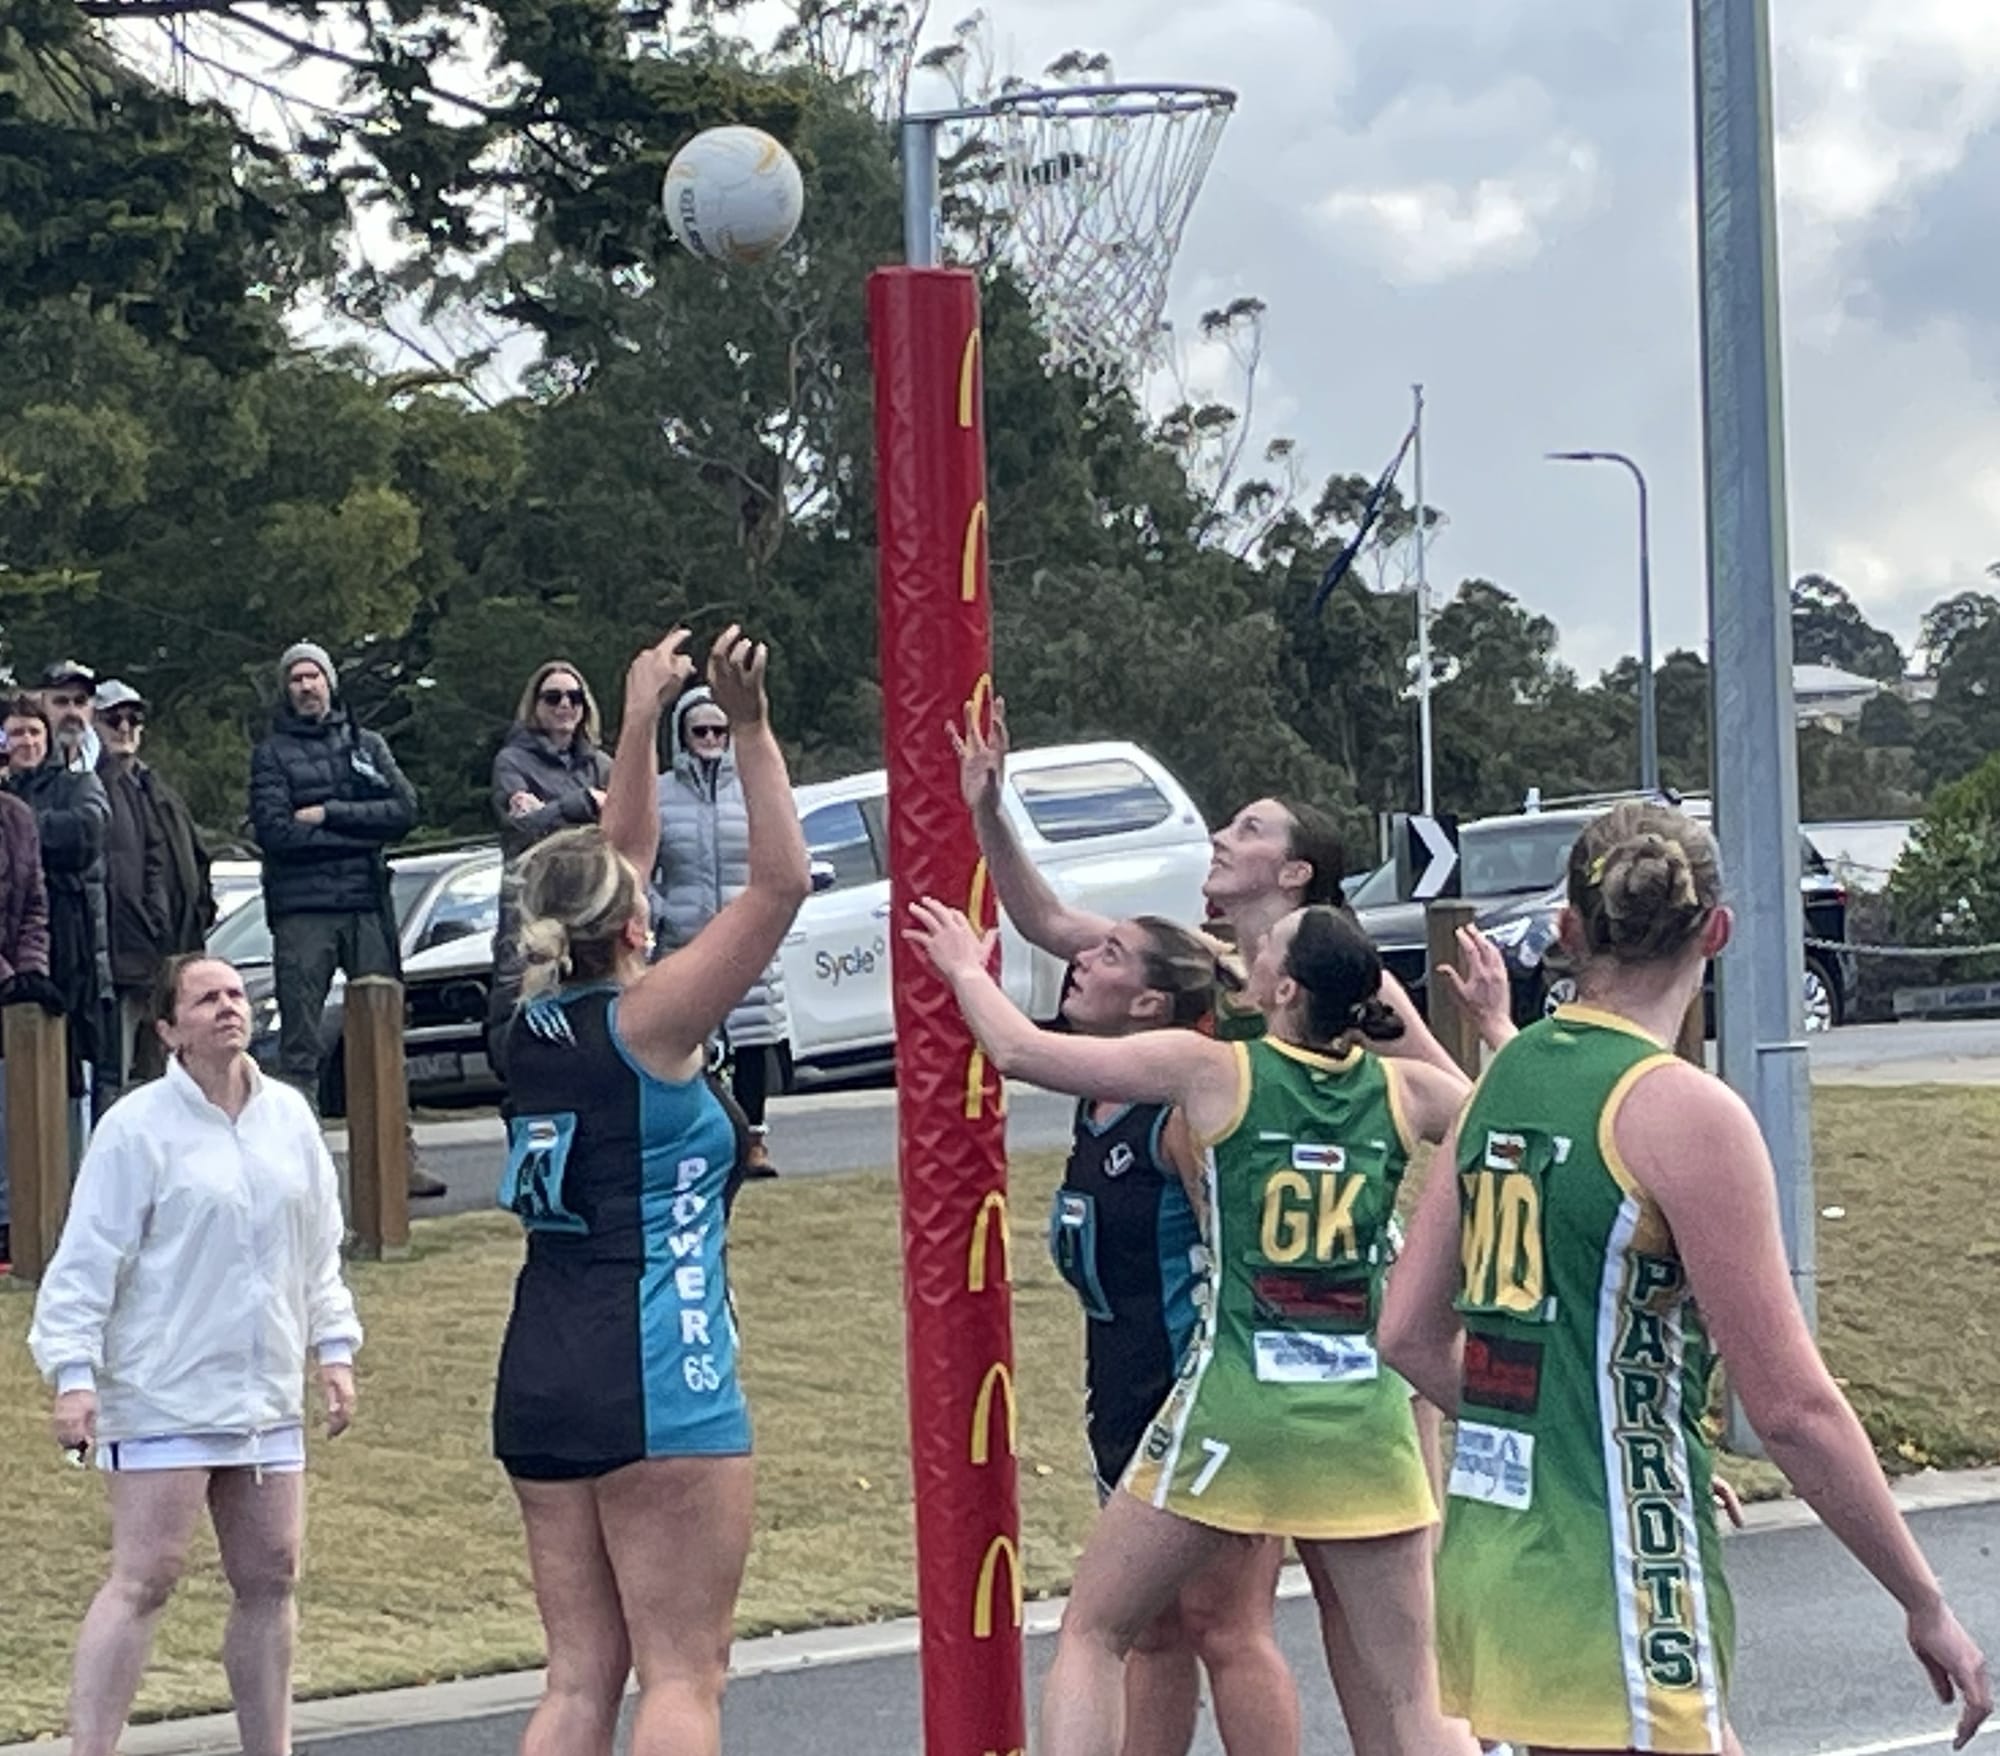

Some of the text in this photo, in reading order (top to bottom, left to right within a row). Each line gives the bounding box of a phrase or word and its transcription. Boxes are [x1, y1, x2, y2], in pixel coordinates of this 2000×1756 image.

[668, 1157, 721, 1392] POWER 65
[1261, 1170, 1367, 1263] GK
[1190, 1437, 1231, 1496] 7
[1609, 1251, 1698, 1691] PARROTS
